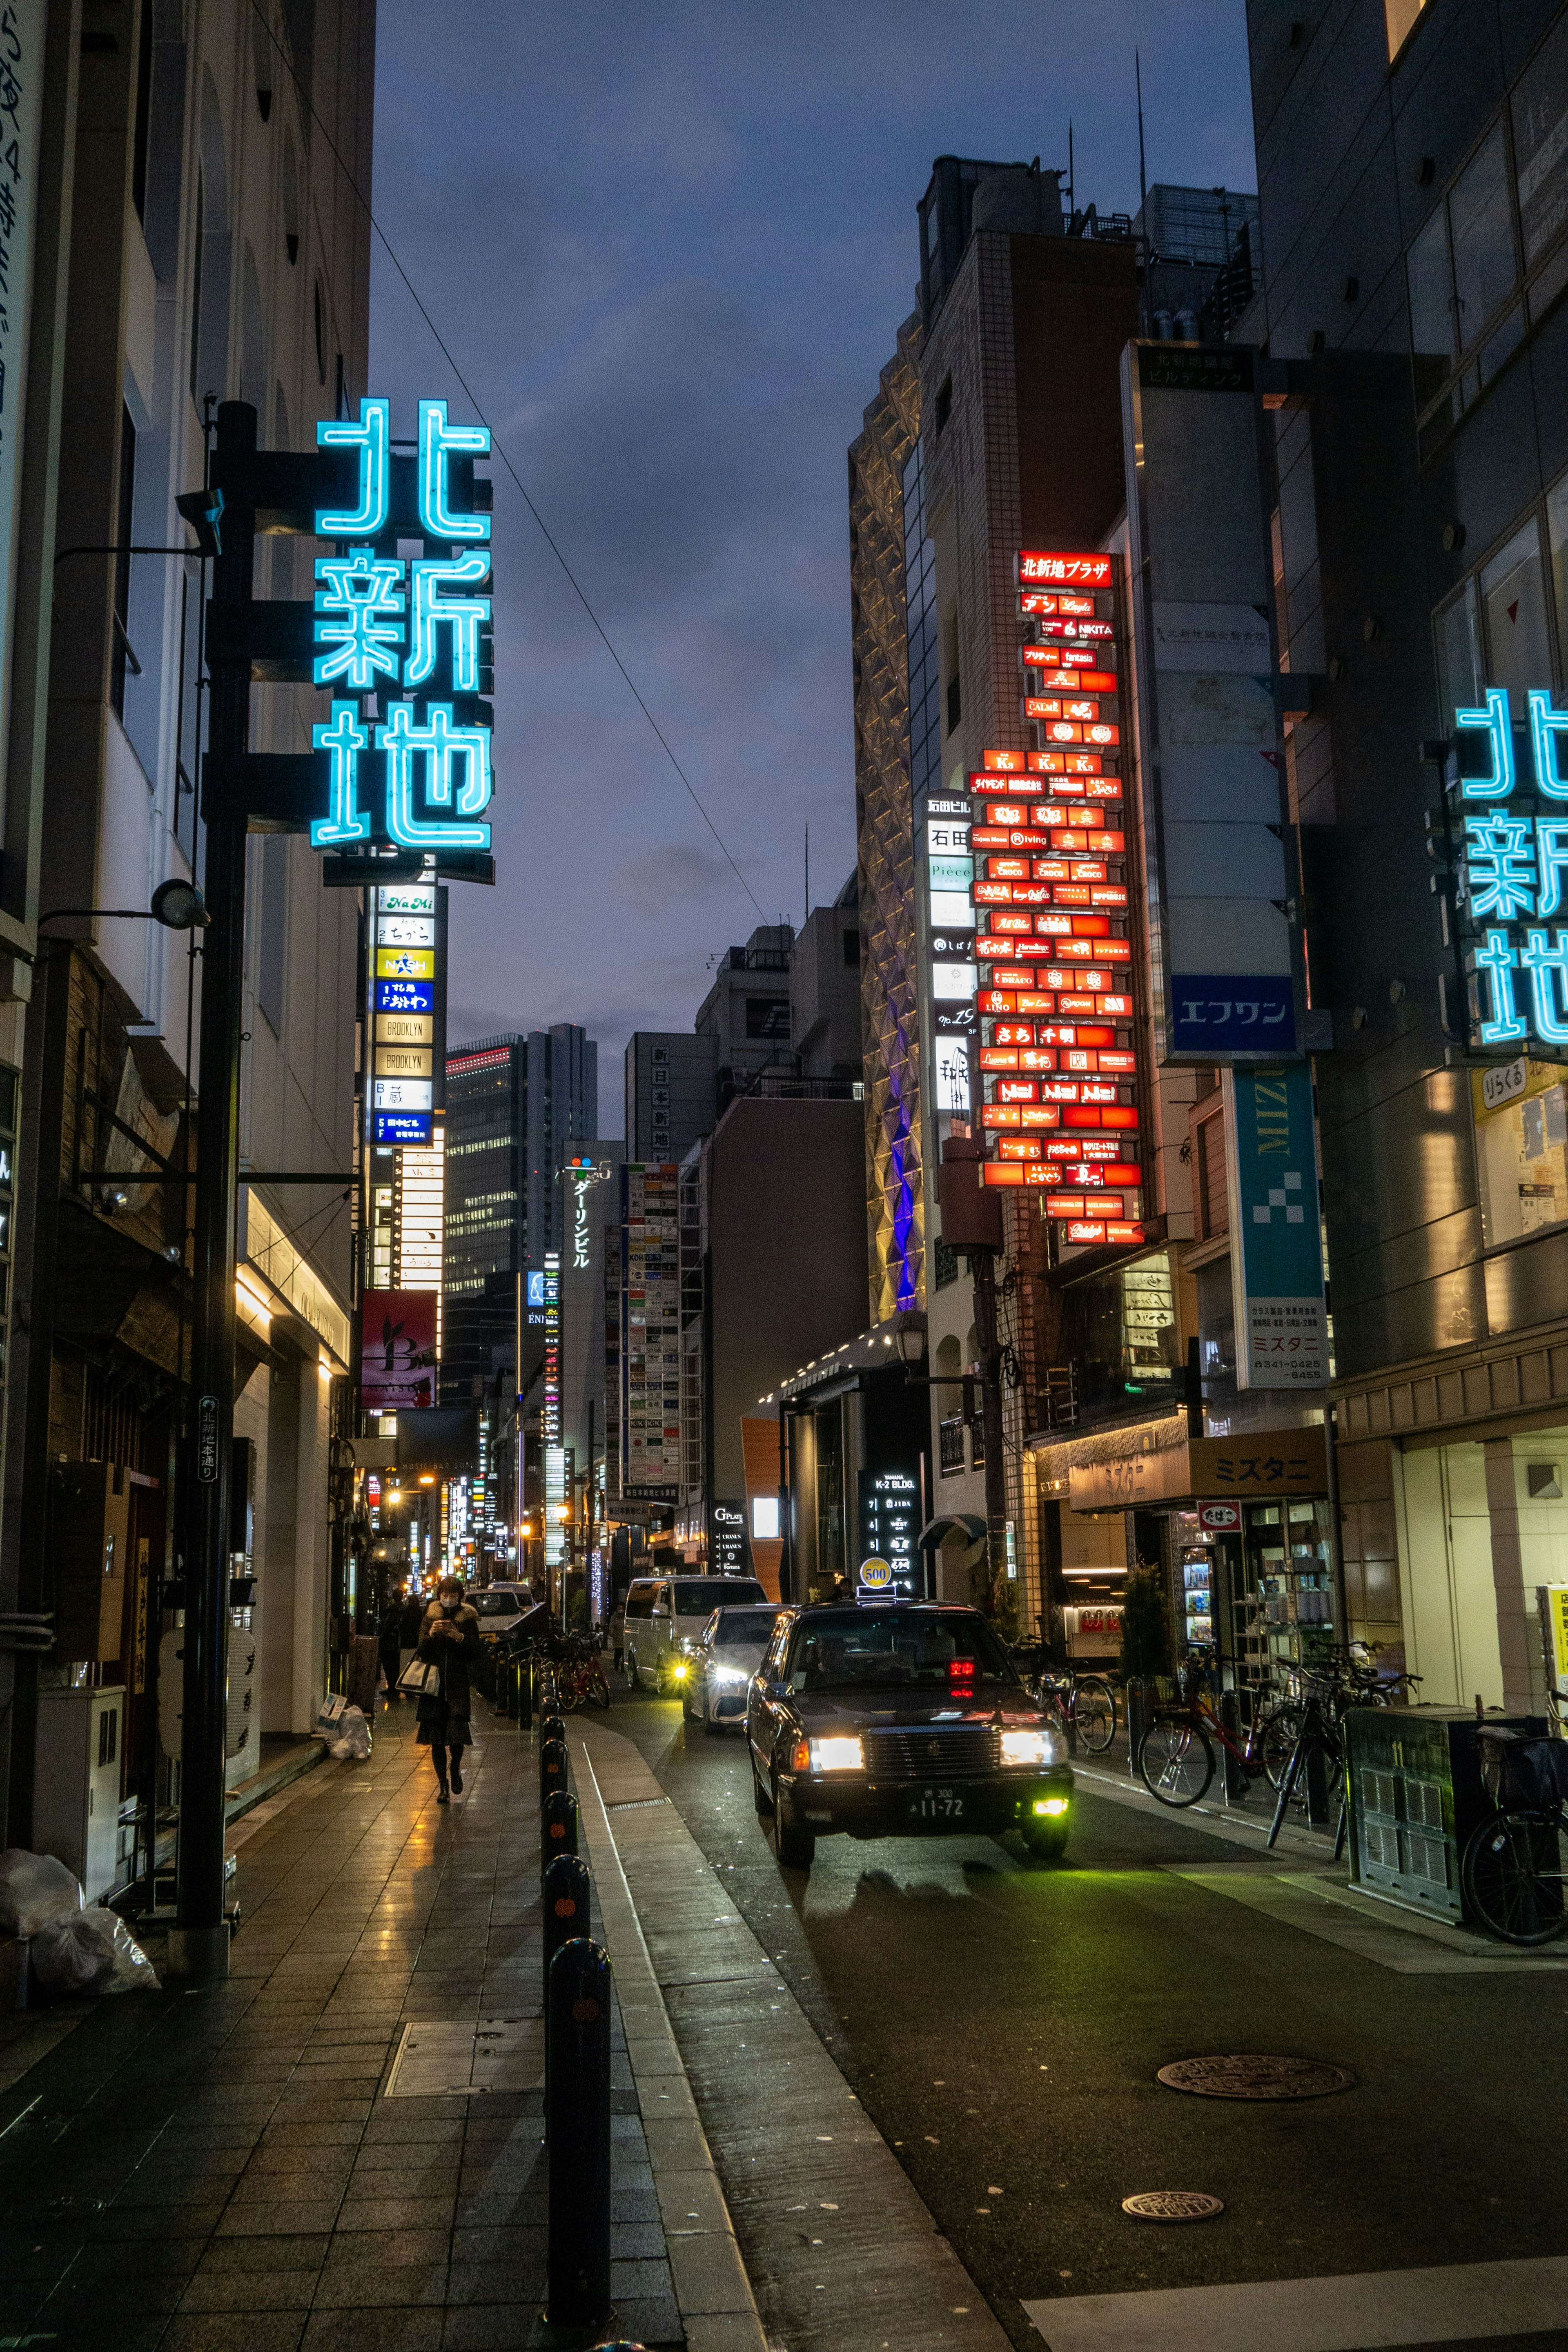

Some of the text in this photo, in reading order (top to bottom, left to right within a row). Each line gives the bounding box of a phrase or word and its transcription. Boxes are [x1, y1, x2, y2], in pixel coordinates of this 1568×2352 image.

[1022, 559, 1108, 579] 北新地プラザ
[1062, 601, 1091, 613] Layla
[311, 398, 490, 847] 北新地
[1079, 625, 1112, 634] NIKITA
[1025, 651, 1057, 661] プリティー
[1065, 653, 1093, 662] fantasia
[976, 779, 1005, 789] ダイヤモンド
[928, 800, 971, 813] 石田ビル
[933, 865, 970, 877] Pièce
[391, 927, 428, 941] ちから
[977, 940, 1012, 955] 花水木
[1016, 943, 1049, 952] Hermitage
[385, 960, 425, 971] NASH
[1180, 1001, 1285, 1024] エフワン
[388, 1022, 422, 1036] BROOKLYN
[998, 1027, 1030, 1042] さち
[387, 1054, 421, 1069] BROOKLYN
[981, 1053, 1007, 1065] Luana
[1071, 1054, 1085, 1067] CRC
[1486, 1064, 1522, 1100] りらくる
[388, 1119, 419, 1127] 田中ビル
[573, 1180, 590, 1268] ダーリンビル
[1254, 1336, 1318, 1352] ミズタニ
[201, 1412, 215, 1477] 北新地本通り
[1216, 1457, 1310, 1483] ミズタニ
[875, 1480, 915, 1489] K-2 BLDG.
[1205, 1510, 1234, 1523] たばこ
[865, 1568, 886, 1581] 500
[951, 1663, 973, 1675] 空車
[922, 1800, 963, 1816] 11-72
